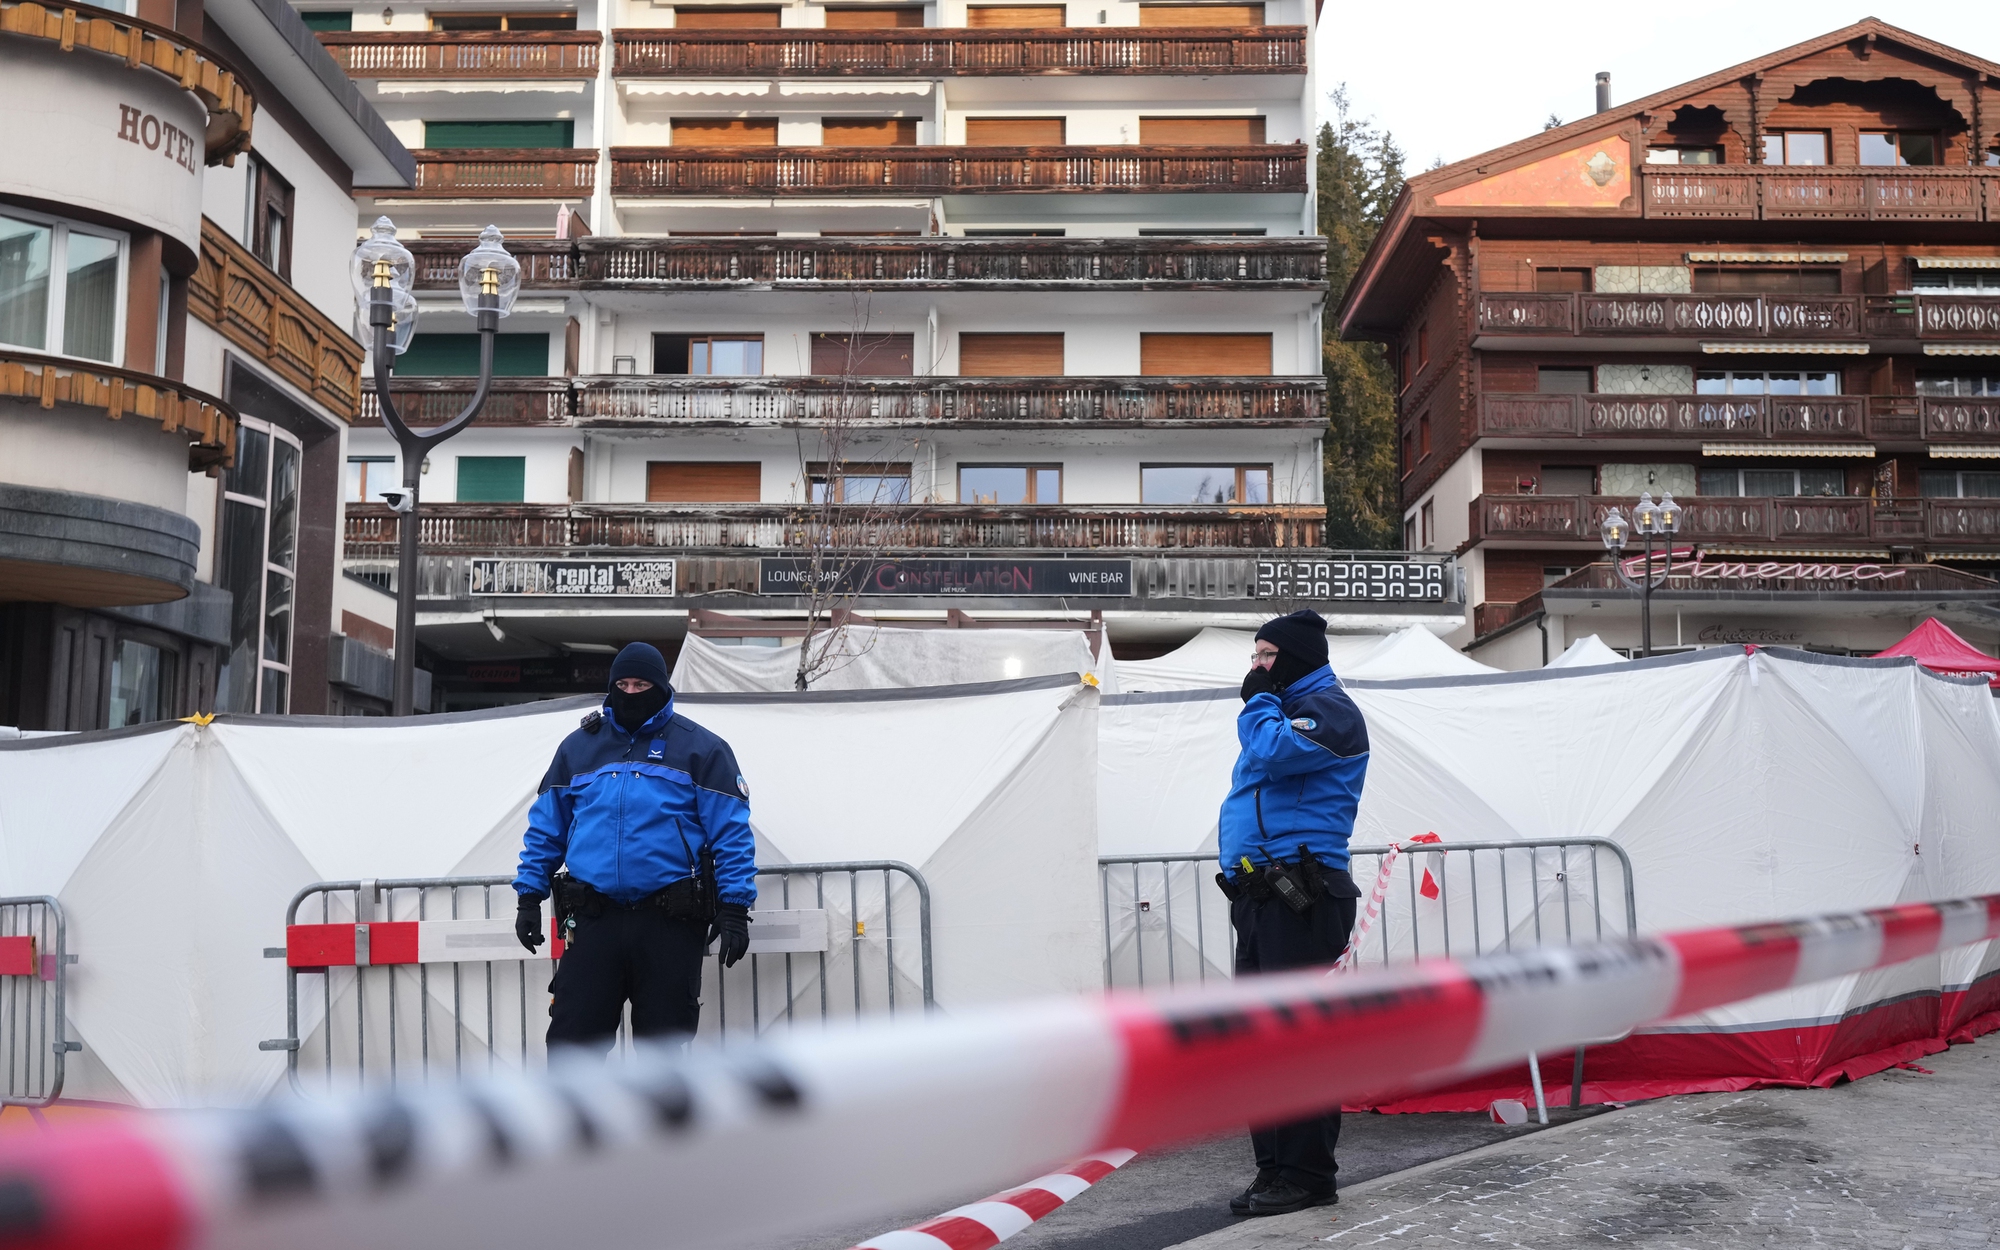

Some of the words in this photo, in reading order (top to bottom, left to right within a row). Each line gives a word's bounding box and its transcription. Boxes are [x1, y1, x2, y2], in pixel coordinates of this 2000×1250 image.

[117, 103, 196, 176] HOTEL
[616, 563, 672, 572] LOCATIONS
[1621, 546, 1907, 580] Cinema
[555, 565, 614, 585] rental
[768, 570, 813, 582] LOUNGE
[817, 570, 839, 582] BAR
[1068, 572, 1098, 584] WINE
[1101, 572, 1124, 583] BAR
[629, 579, 663, 587] VENTE
[555, 585, 586, 594] SPORT
[589, 585, 614, 594] SHOP
[469, 669, 517, 679] LOCATION
